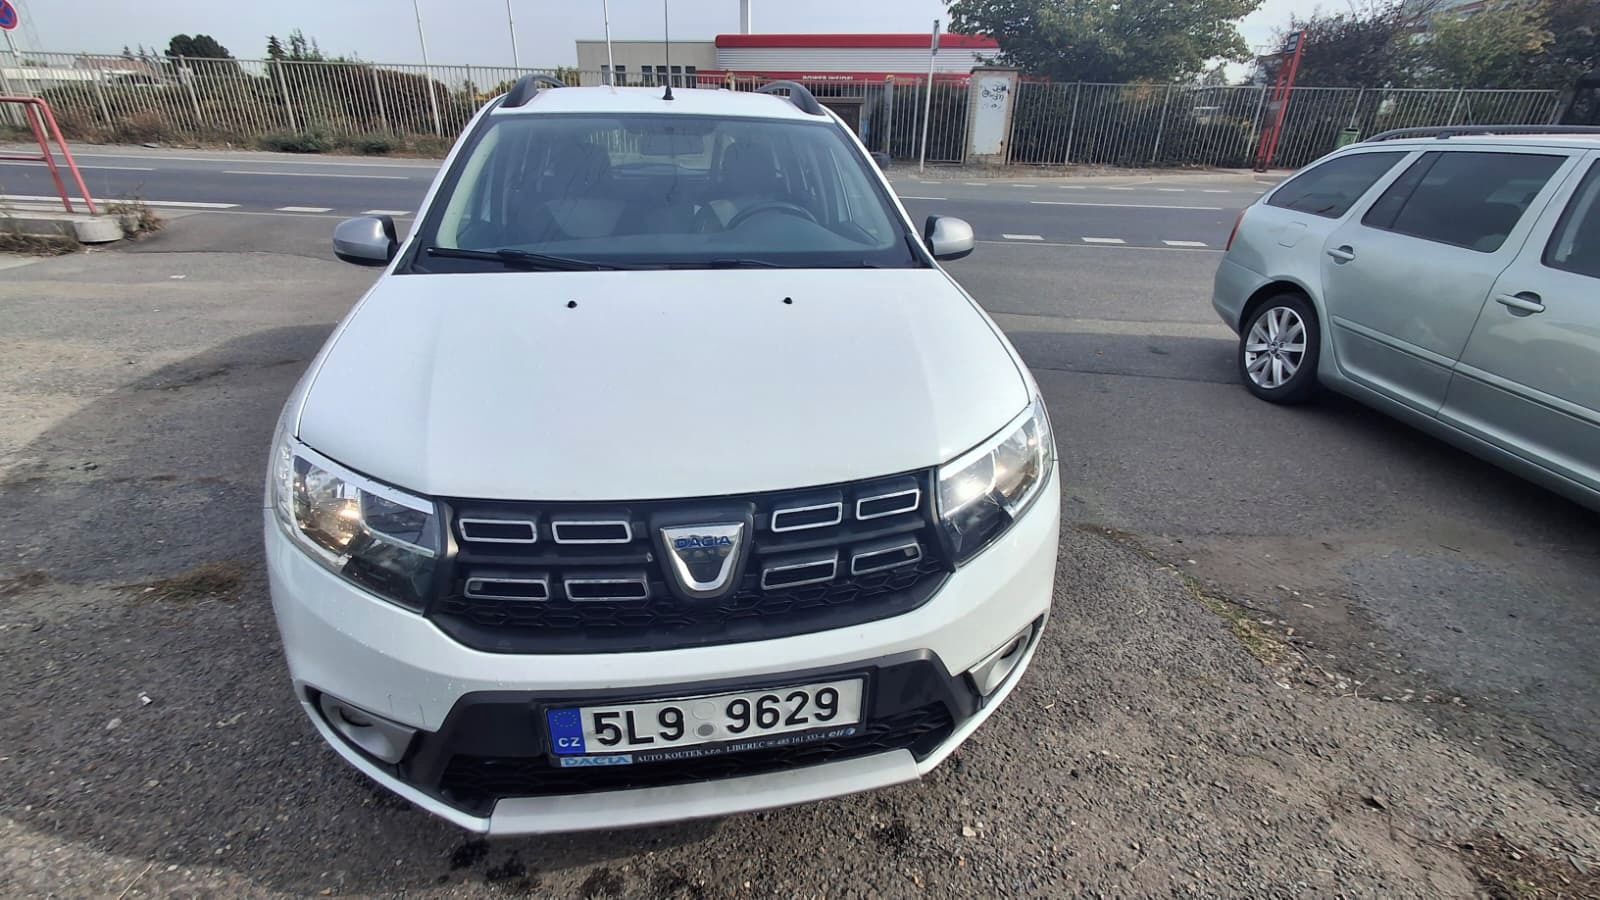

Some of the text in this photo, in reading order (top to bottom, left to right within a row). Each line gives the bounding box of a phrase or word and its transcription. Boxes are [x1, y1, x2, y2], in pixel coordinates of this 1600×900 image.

[673, 535, 732, 549] DACIA
[593, 687, 840, 746] 5L9 9629
[558, 737, 581, 748] CZ
[562, 756, 631, 766] DACIA
[638, 753, 663, 763] AUTO
[664, 749, 703, 760] KOUTEK
[726, 741, 766, 753] LIBEREC
